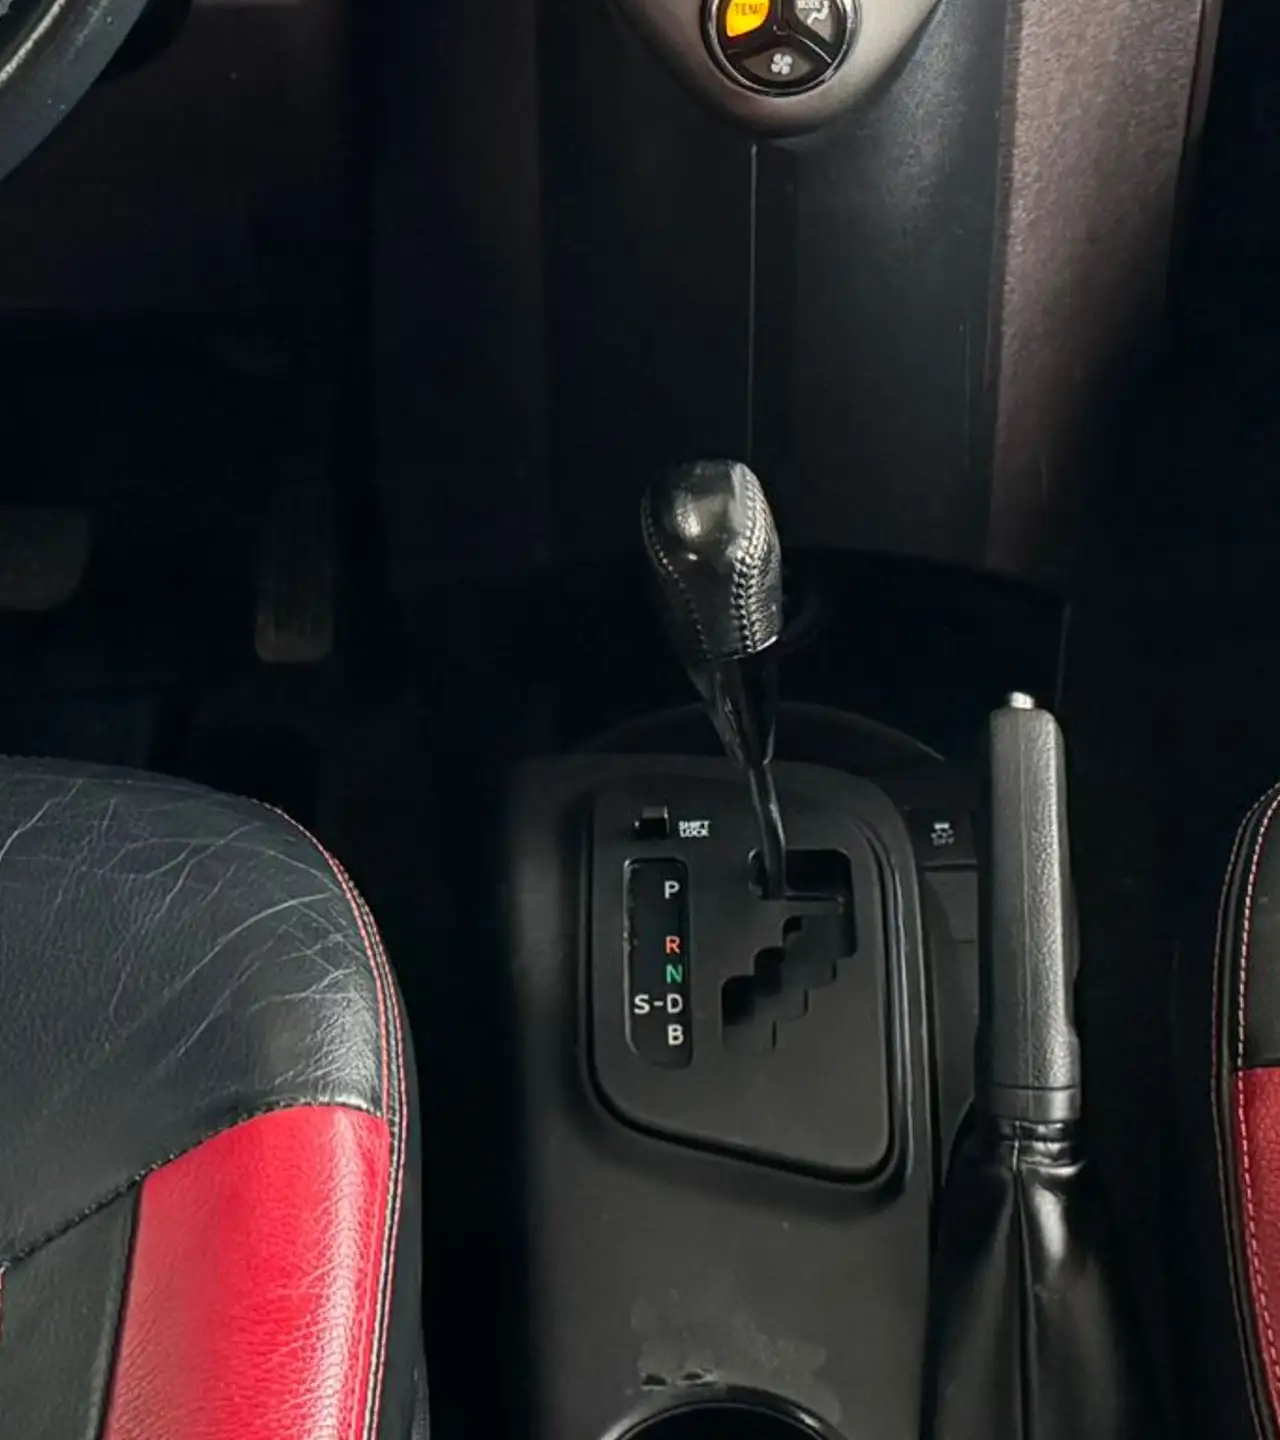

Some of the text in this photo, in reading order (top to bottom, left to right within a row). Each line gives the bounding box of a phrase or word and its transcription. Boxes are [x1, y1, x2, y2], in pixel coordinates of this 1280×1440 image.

[735, 2, 766, 17] TEMP
[678, 820, 710, 829] SHIFT
[679, 828, 710, 838] LOCK
[664, 880, 681, 900] P
[665, 935, 682, 954] R
[665, 963, 683, 984] N
[633, 993, 683, 1014] S-D
[667, 1023, 684, 1046] B
